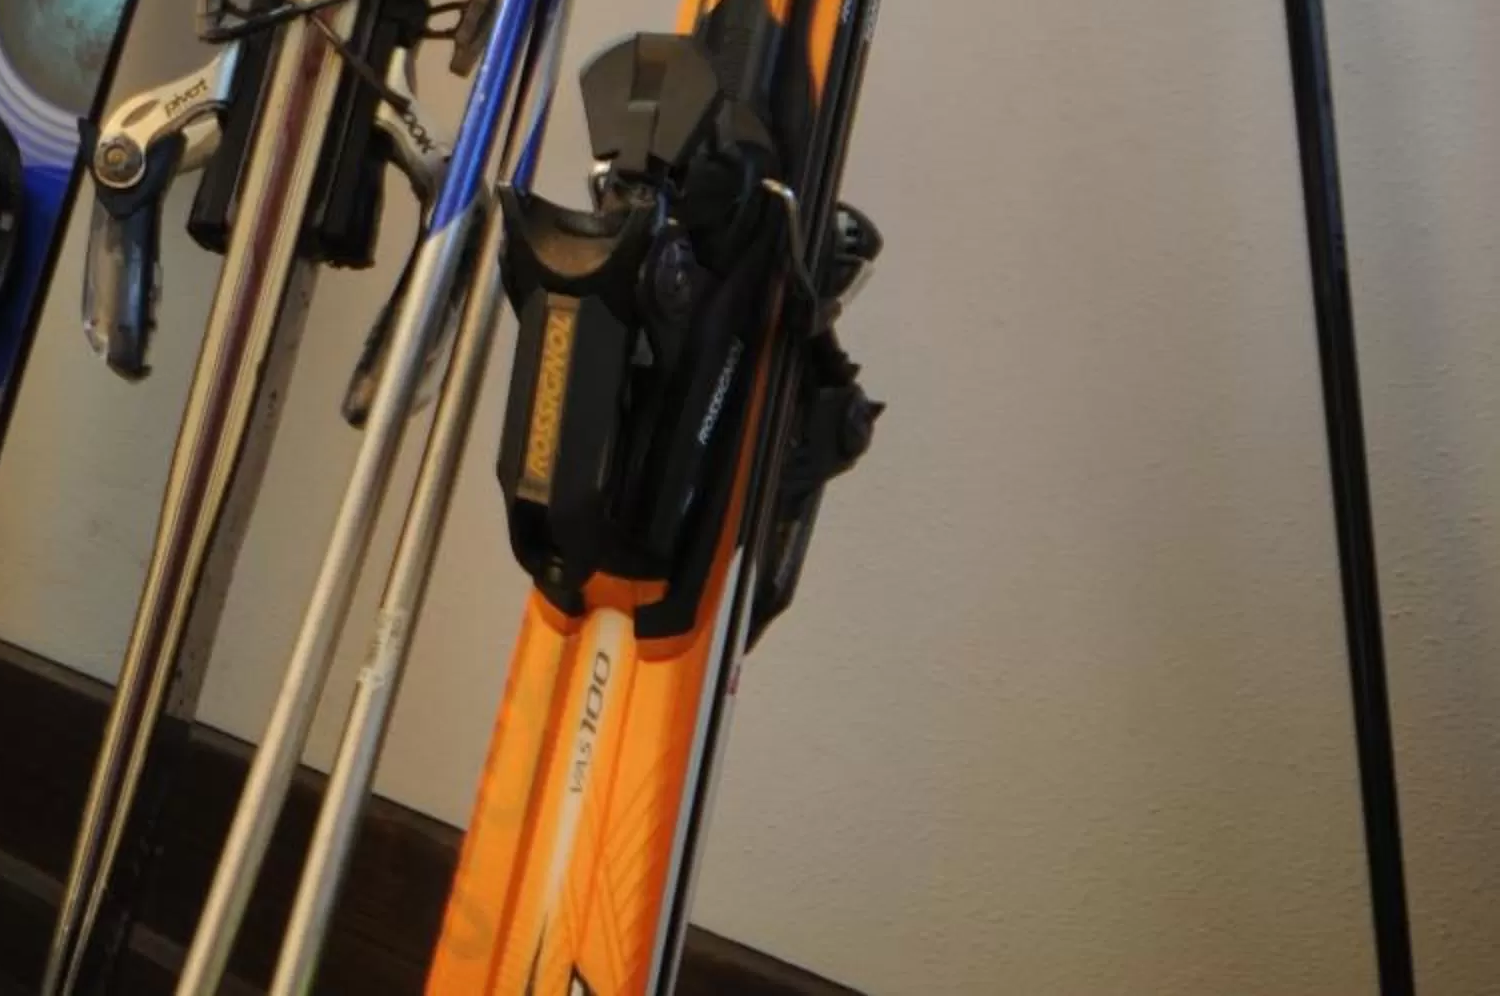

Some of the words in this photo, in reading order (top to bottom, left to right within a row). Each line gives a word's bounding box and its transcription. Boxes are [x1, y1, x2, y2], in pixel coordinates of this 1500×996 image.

[400, 110, 436, 154] OOK
[529, 312, 573, 479] ROSSIGNOL
[579, 651, 611, 735] 100
